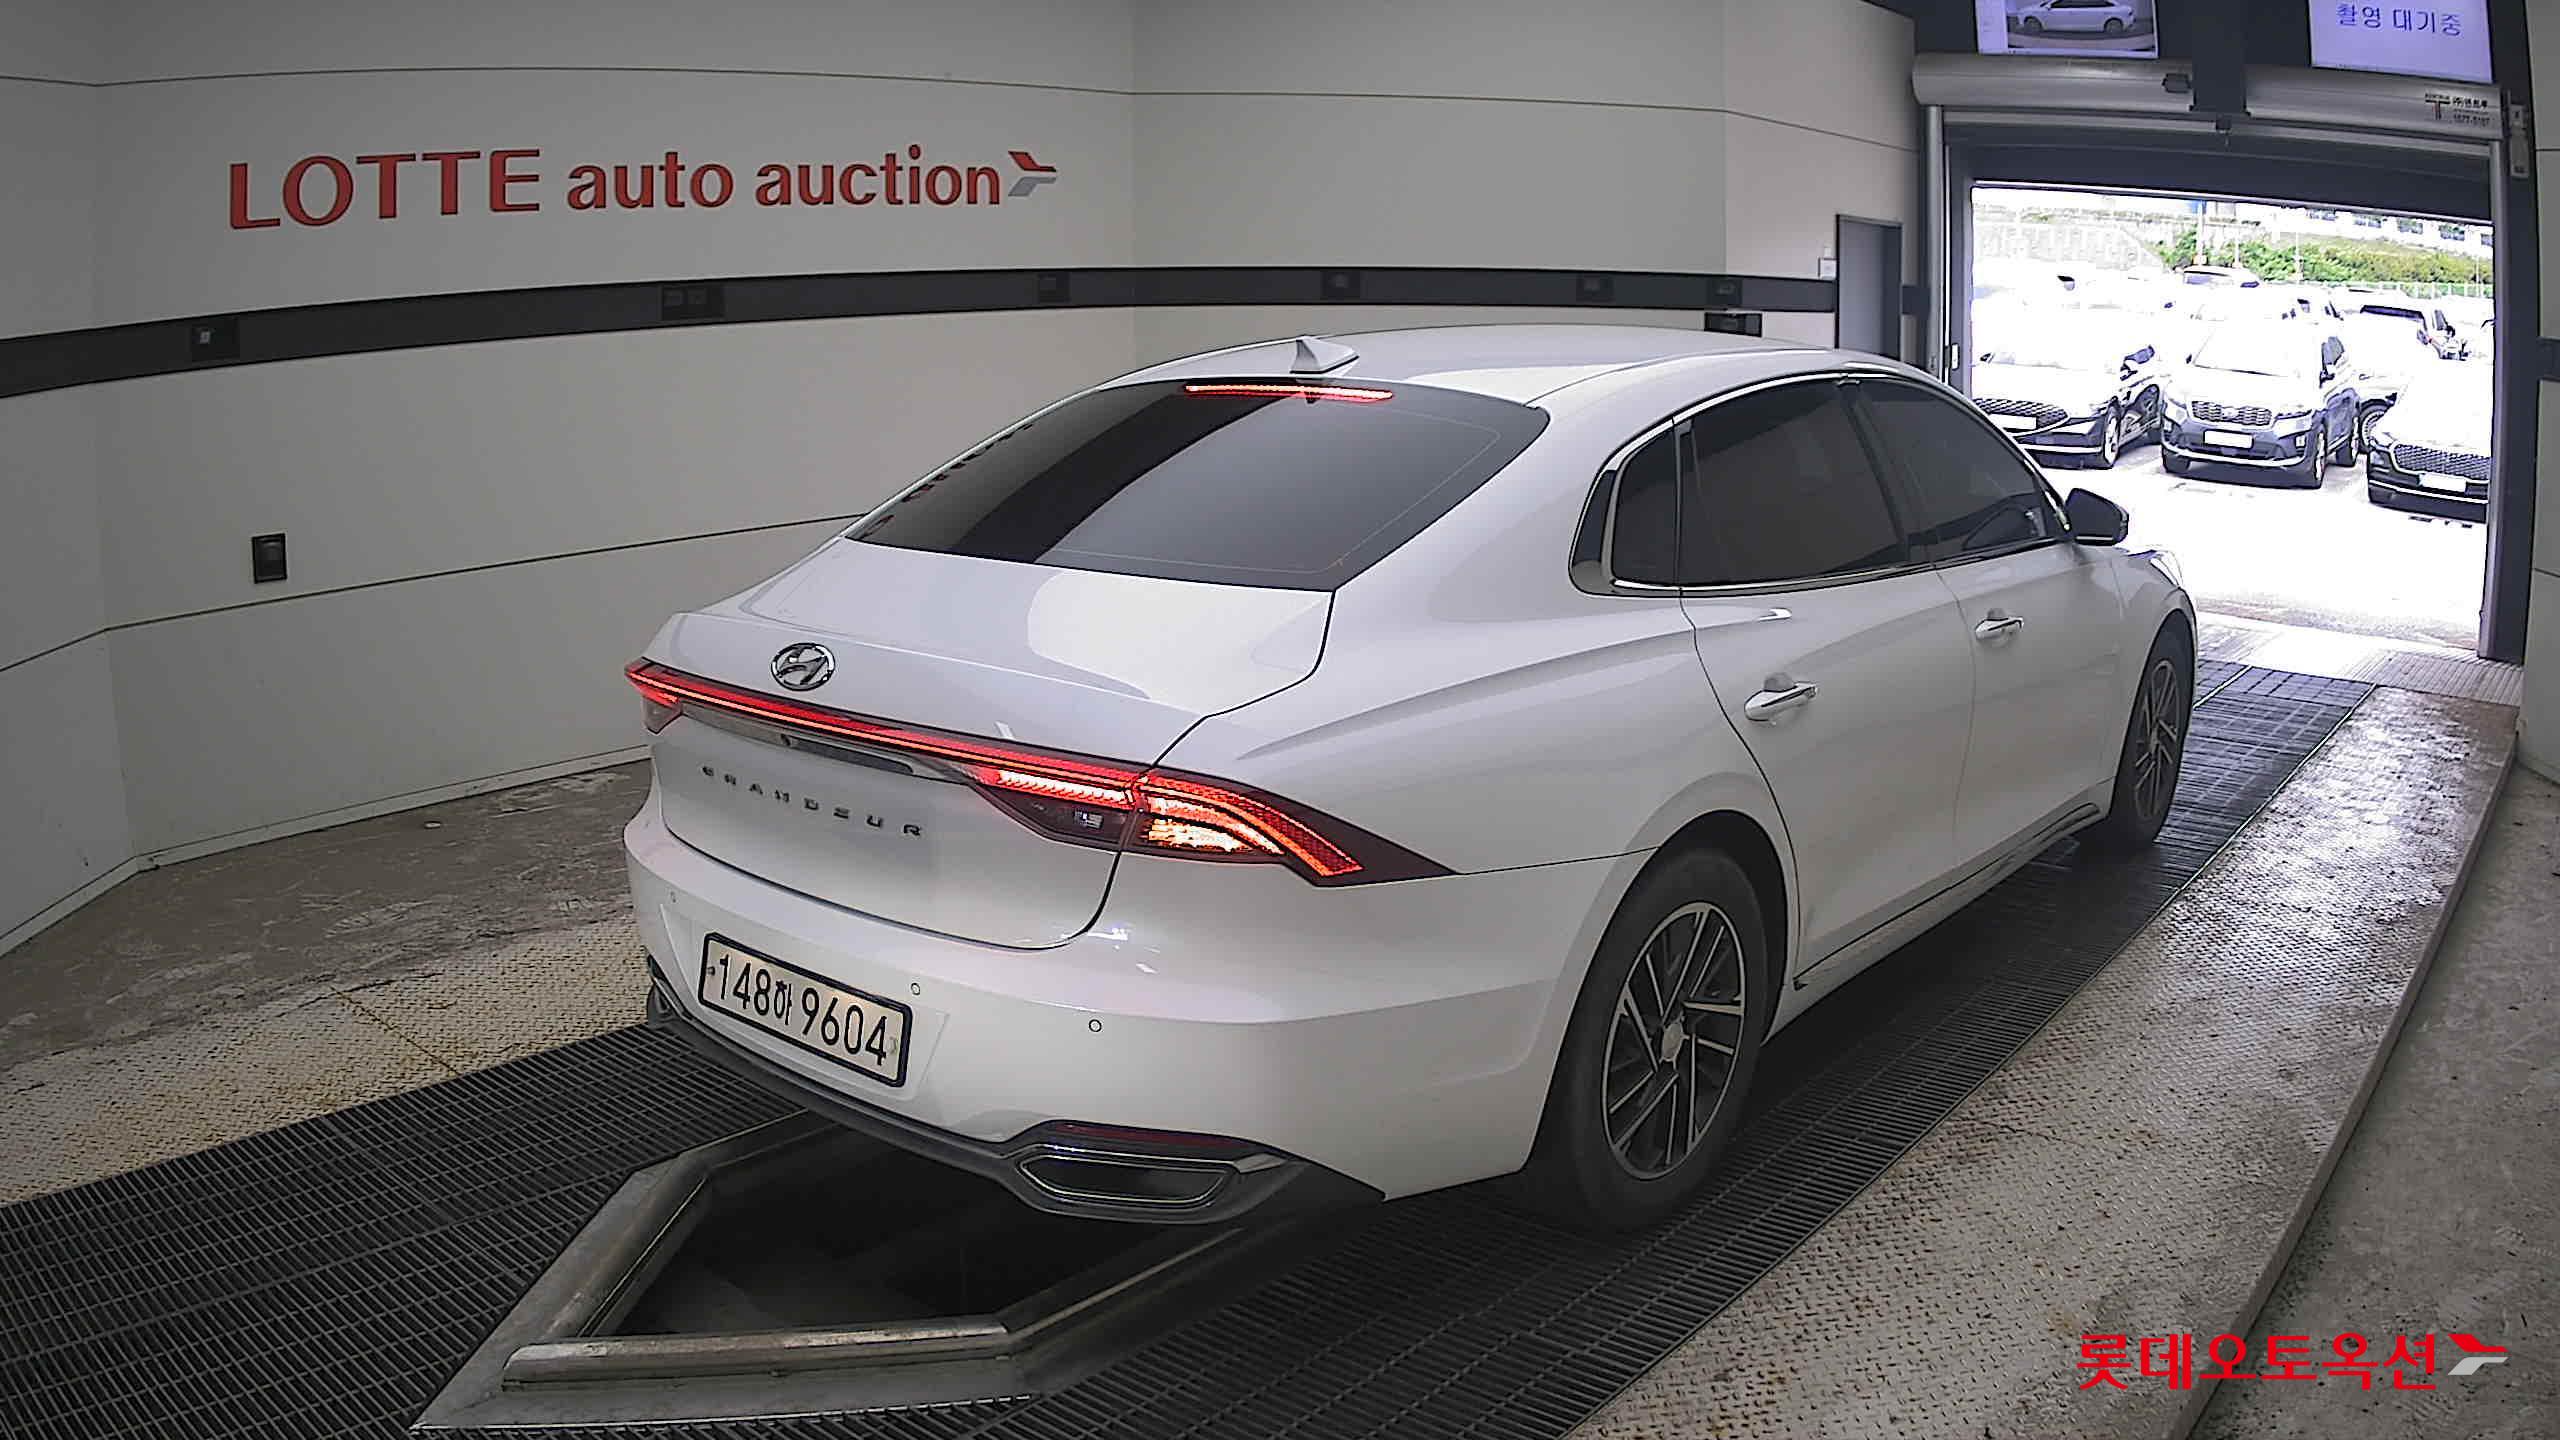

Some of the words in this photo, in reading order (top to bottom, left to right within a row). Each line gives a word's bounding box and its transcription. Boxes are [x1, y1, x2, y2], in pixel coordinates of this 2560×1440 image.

[2338, 3, 2381, 28] 촬영
[2392, 8, 2461, 37] 대기중
[230, 149, 540, 229] LOTTE
[567, 150, 734, 209] auto
[755, 144, 1001, 206] auction
[701, 765, 921, 836] GRANDEUR
